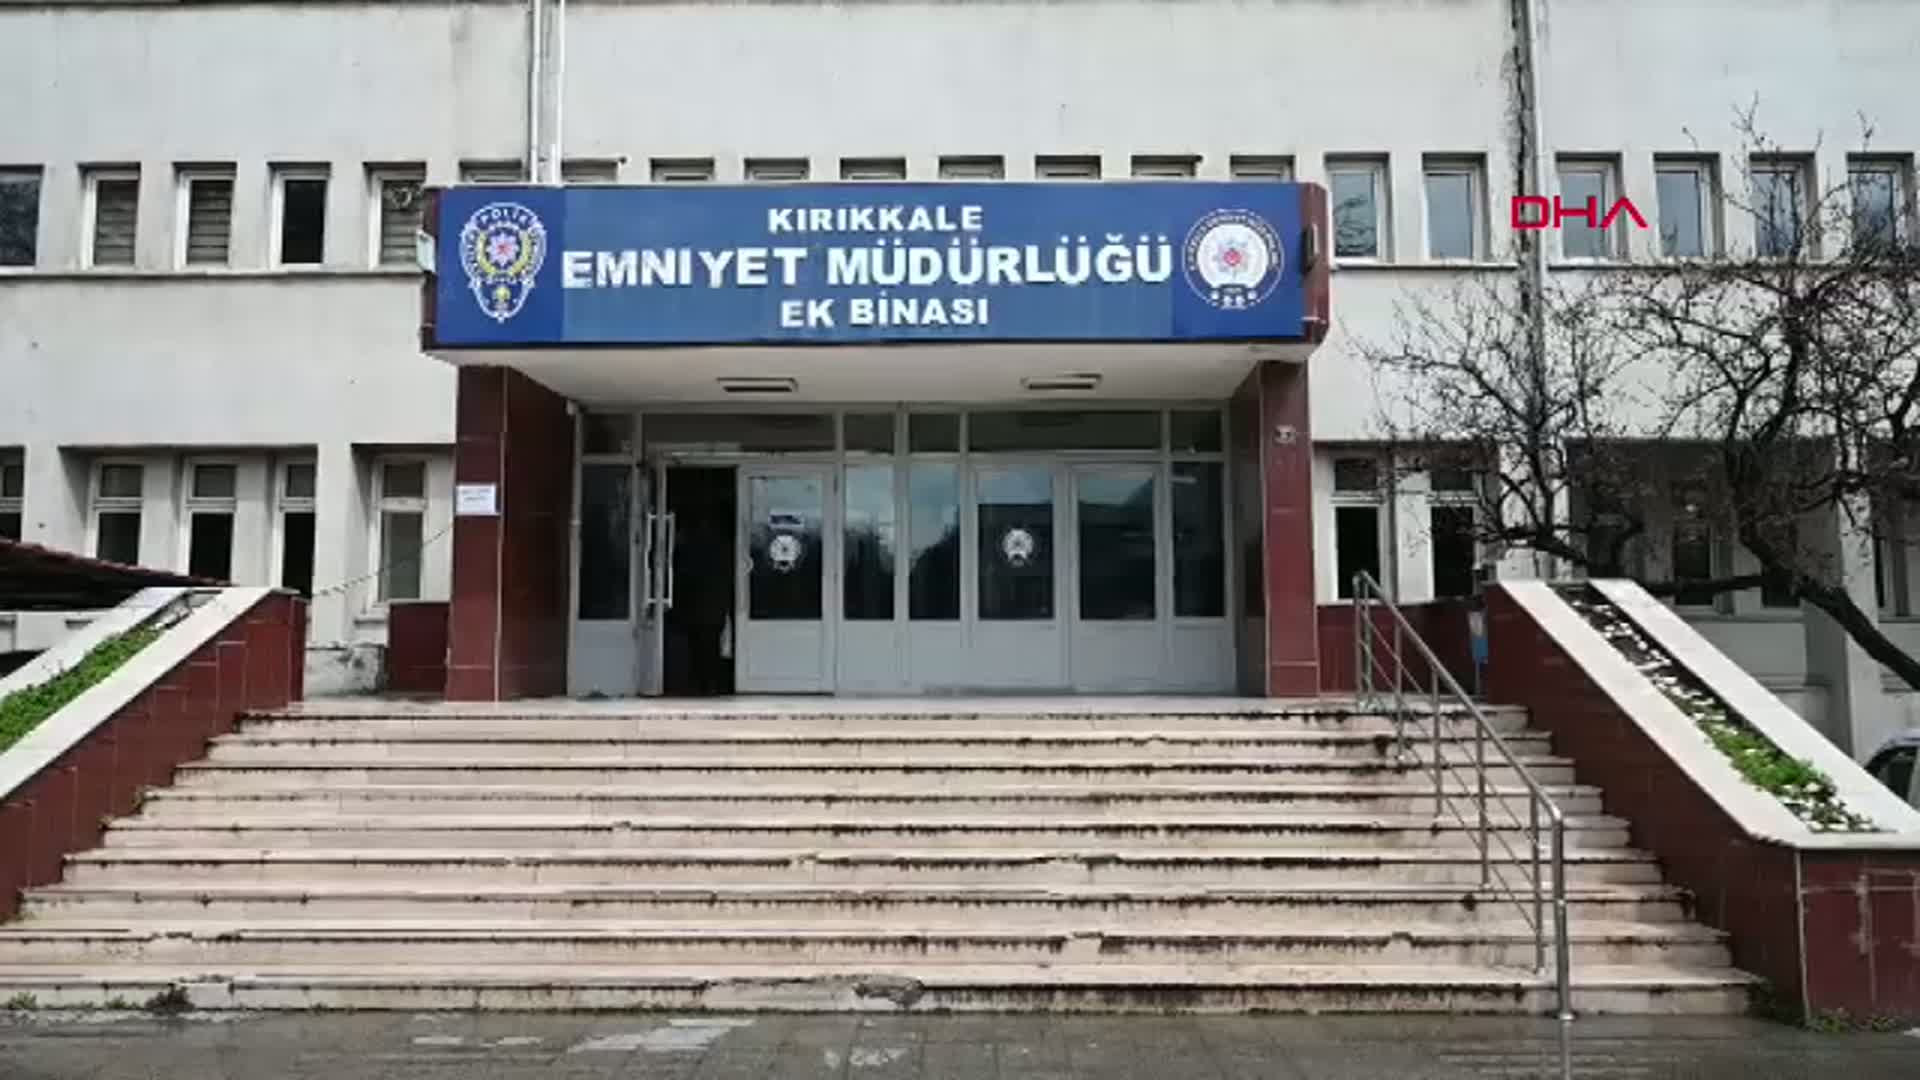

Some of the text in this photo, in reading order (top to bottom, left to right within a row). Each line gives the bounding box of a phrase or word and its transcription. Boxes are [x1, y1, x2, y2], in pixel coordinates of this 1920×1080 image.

[767, 206, 983, 232] KIRIKKALE
[827, 233, 1172, 285] MÜDÜRLÜĞÜ
[781, 290, 988, 328] EK BİNASI
